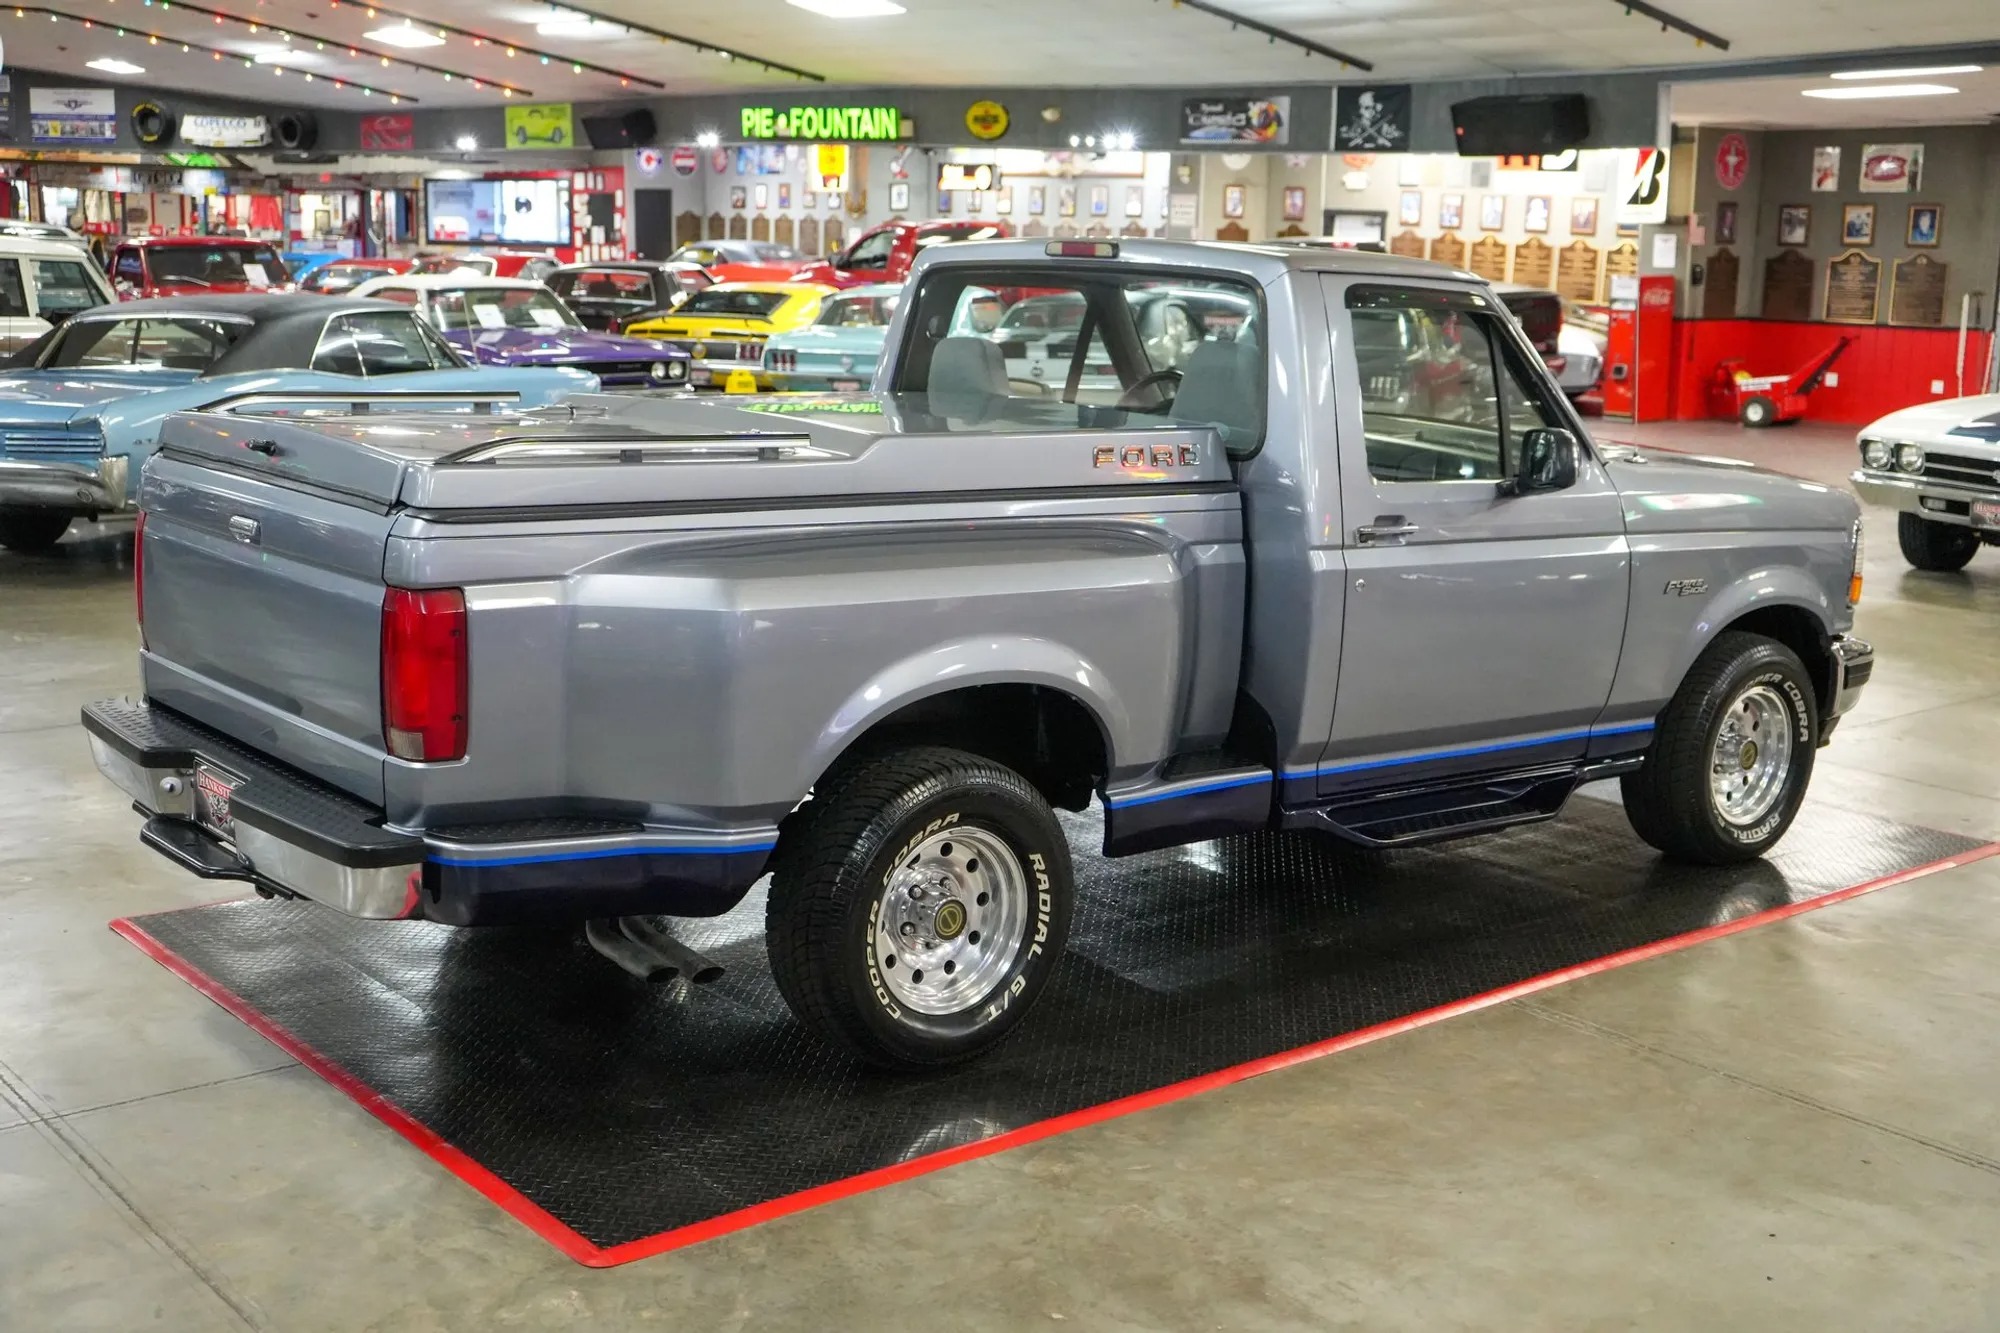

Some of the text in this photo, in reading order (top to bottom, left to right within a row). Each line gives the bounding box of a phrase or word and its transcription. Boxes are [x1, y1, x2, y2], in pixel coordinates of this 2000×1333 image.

[741, 107, 897, 139] PIE FOUNTAIN
[1093, 443, 1201, 468] FORD
[1783, 681, 1809, 742] COBRA
[1729, 812, 1781, 839] RADIAL
[866, 812, 960, 1020] COOPER COBRA
[987, 853, 1052, 1023] RADIAL G/T
